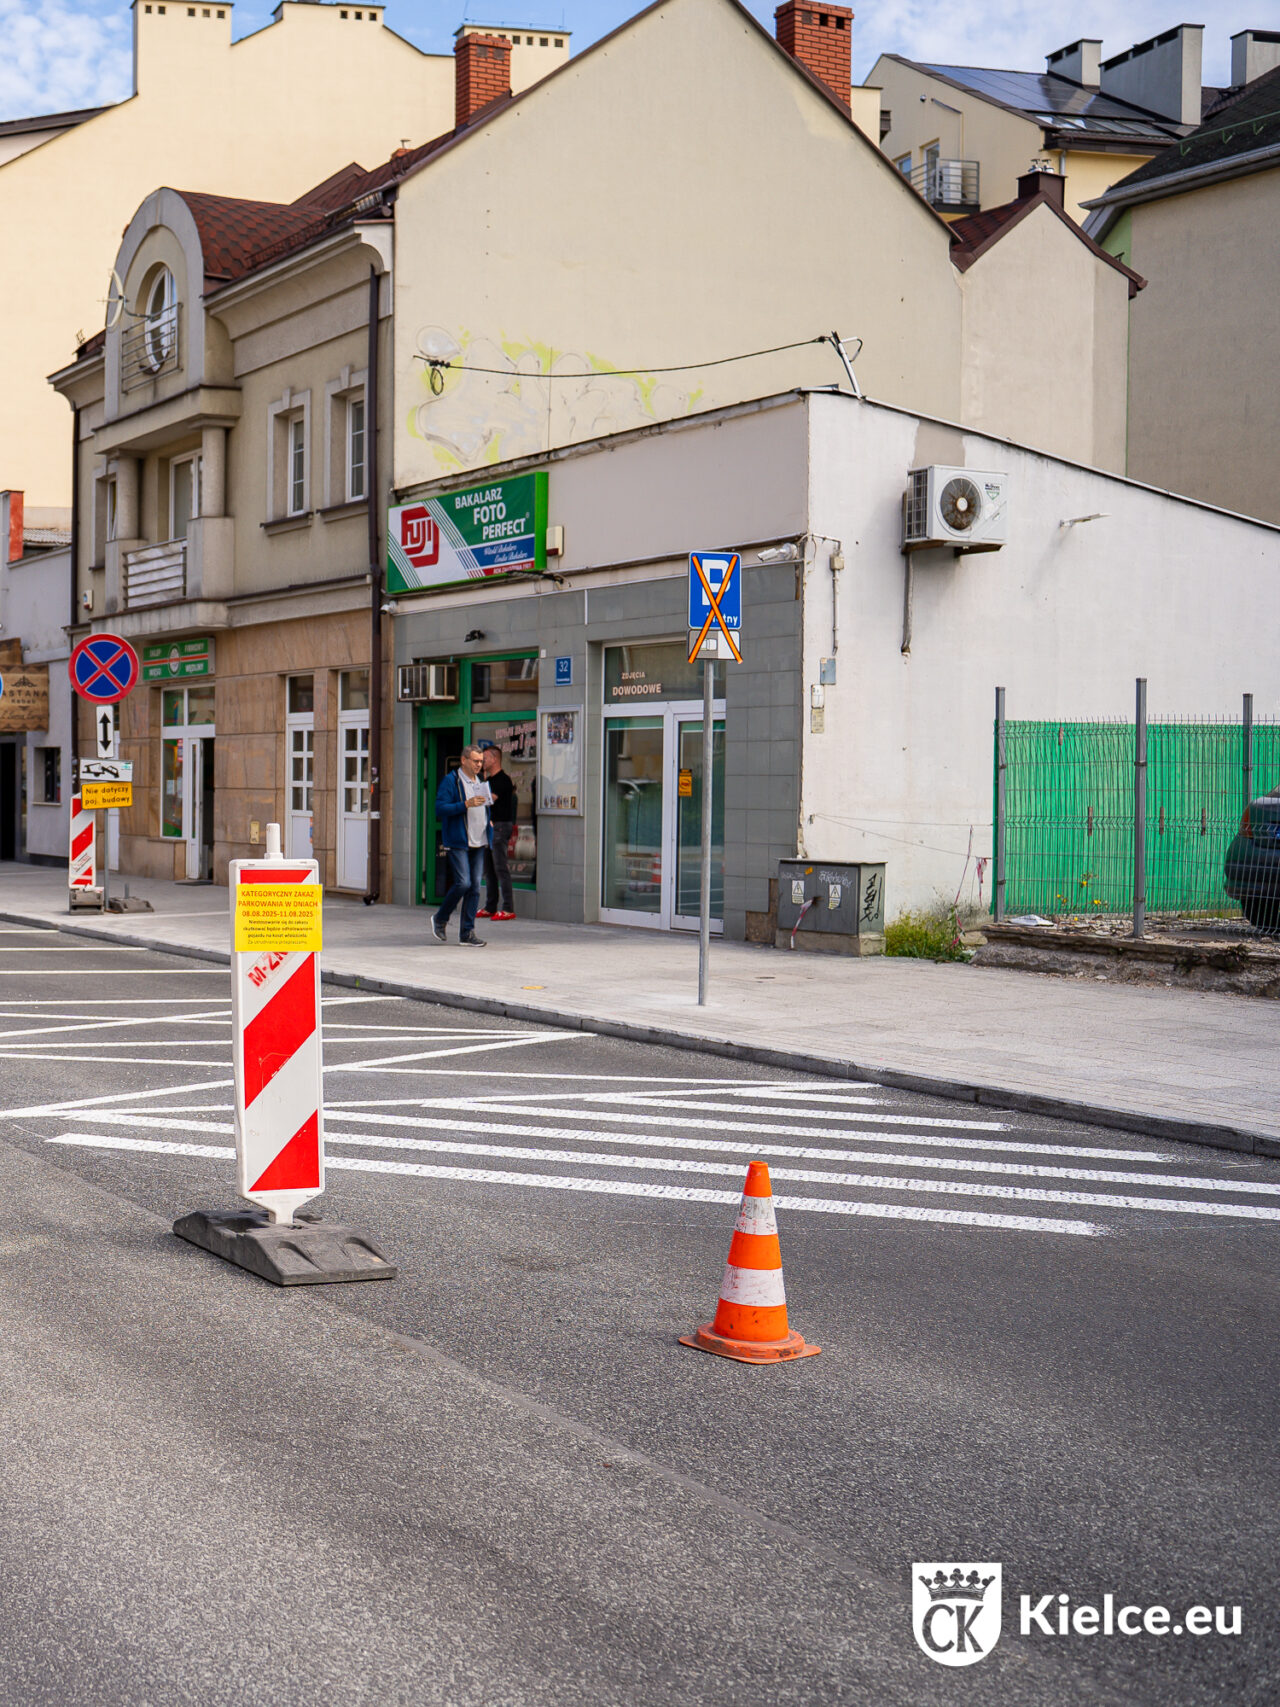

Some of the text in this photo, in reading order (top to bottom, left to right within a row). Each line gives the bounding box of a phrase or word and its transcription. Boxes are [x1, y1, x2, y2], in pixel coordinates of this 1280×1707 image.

[455, 487, 502, 509] BAKALARZ
[473, 502, 506, 525] FOTO
[482, 518, 526, 540] PERFECT
[559, 660, 569, 672] 32
[621, 672, 646, 680] ZDJĘCIA
[612, 684, 662, 696] DOWODOWE
[101, 786, 129, 794] dotyczy
